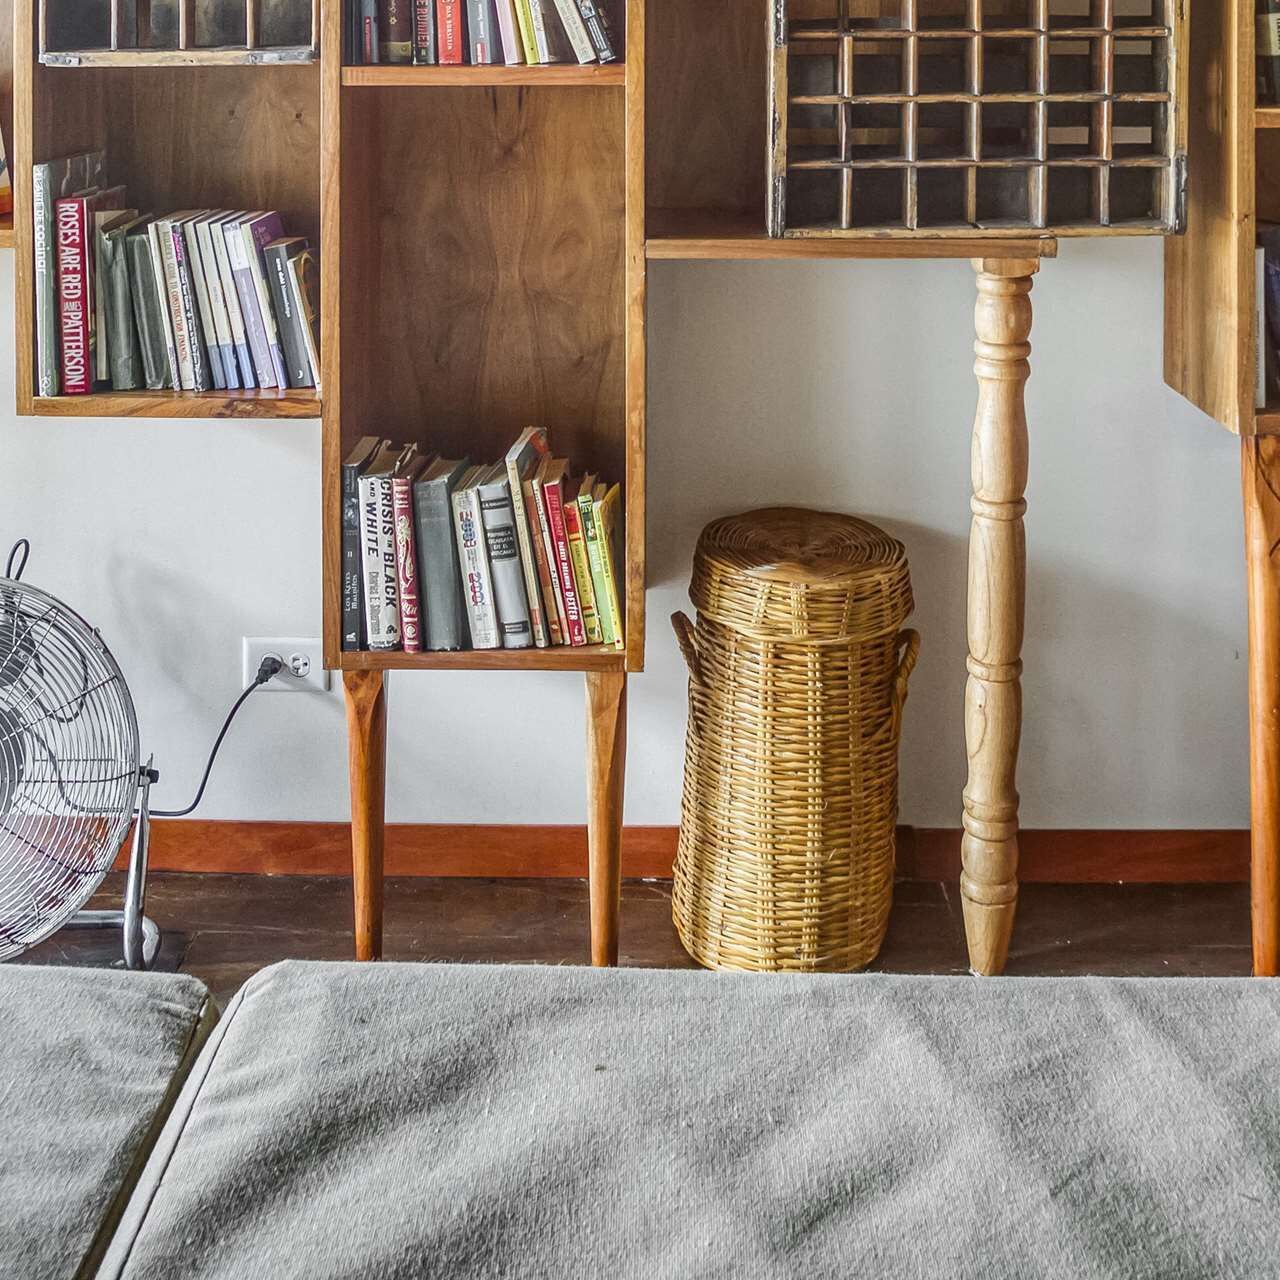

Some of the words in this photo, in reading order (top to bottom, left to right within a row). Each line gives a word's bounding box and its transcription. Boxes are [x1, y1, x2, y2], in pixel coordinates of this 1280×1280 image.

[416, 7, 430, 48] RUNNER
[59, 203, 80, 244] ROSES
[35, 225, 47, 273] cocinar
[60, 246, 80, 270] ARE
[61, 274, 82, 298] RED
[170, 290, 184, 332] CONSTRUCTION
[62, 311, 84, 385] PATTERSON
[379, 479, 394, 535] CRISIS
[364, 501, 379, 557] WHITE
[382, 551, 396, 608] BLACK
[565, 606, 581, 640] DEXTER
